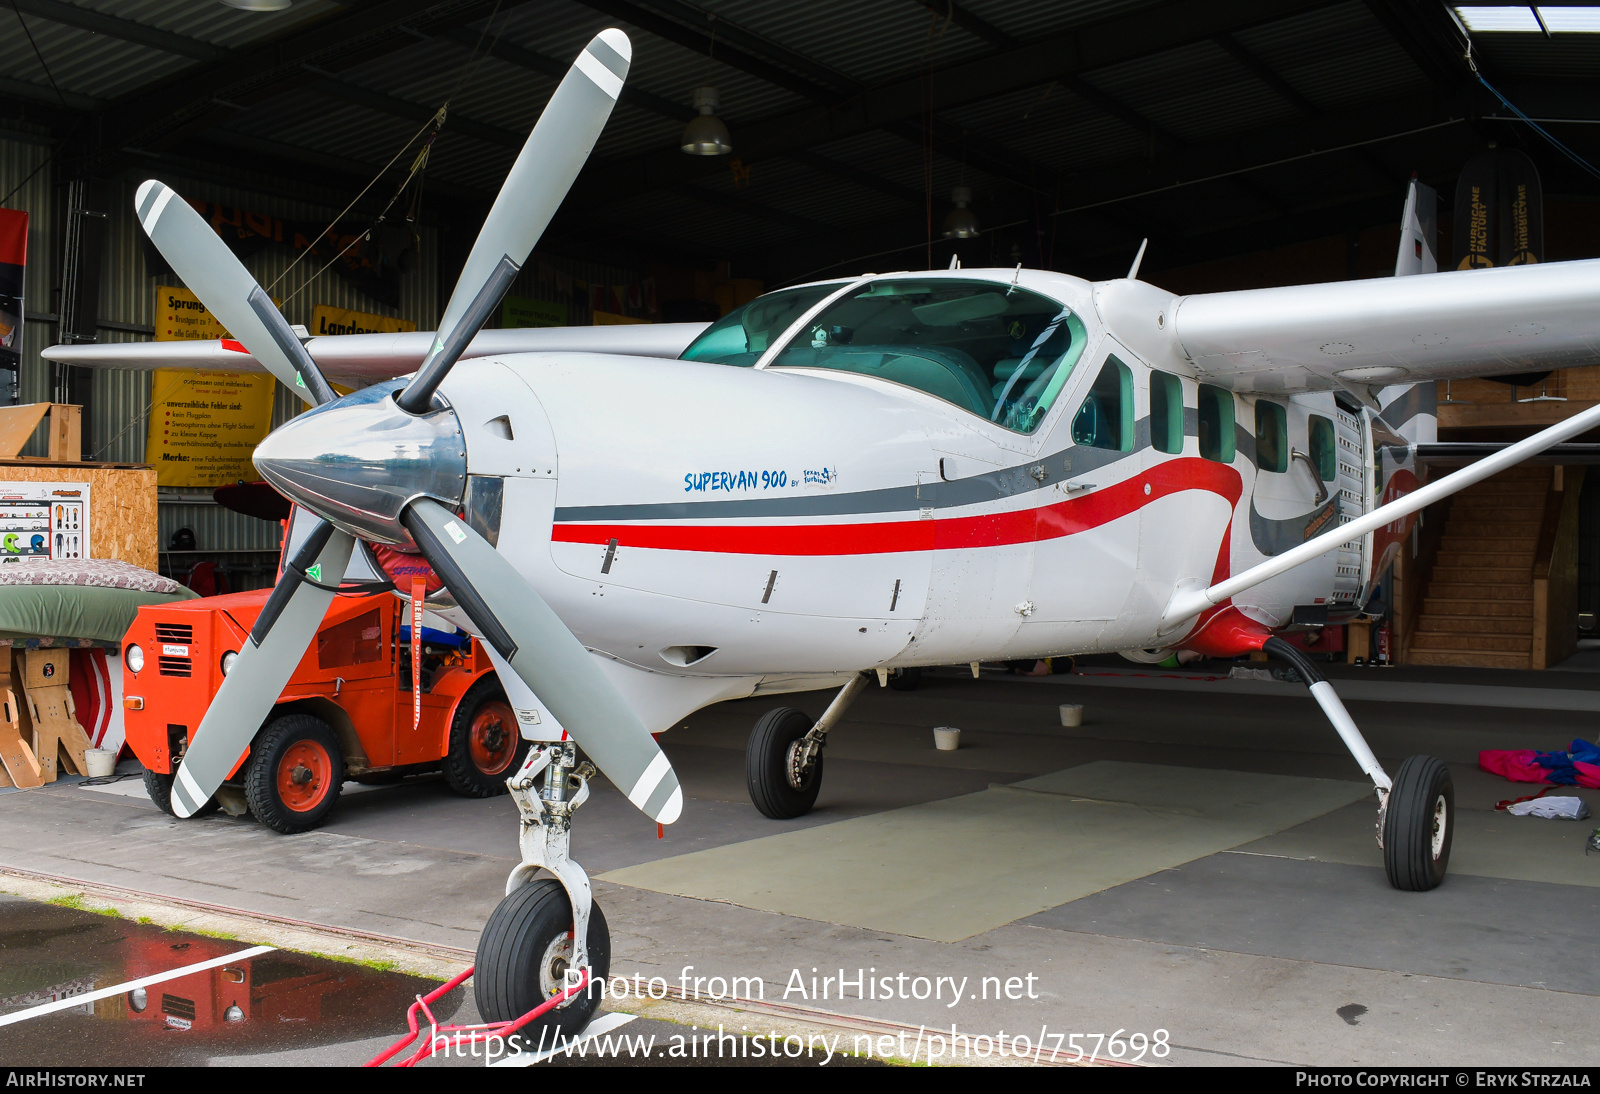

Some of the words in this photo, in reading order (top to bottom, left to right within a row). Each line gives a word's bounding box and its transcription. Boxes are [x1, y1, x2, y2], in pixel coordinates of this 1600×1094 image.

[1470, 186, 1480, 253] HURRICANE
[1477, 203, 1487, 253] FACTORY
[168, 296, 209, 313] Sprung
[175, 315, 199, 326] Brustgurt
[174, 329, 184, 338] alle
[185, 330, 200, 339] Griffe
[201, 331, 208, 339] da
[225, 380, 253, 388] mitdenken
[166, 401, 209, 409] unverzeihliche
[210, 402, 228, 410] Fehler
[228, 402, 243, 410] sind:
[171, 421, 206, 429] Swoopturns
[199, 431, 218, 439] Kappe
[170, 440, 223, 449] unverhältnismäßig
[162, 453, 190, 462] Merke:
[204, 455, 245, 464] Fallschirmkappe
[684, 470, 758, 492] SUPERVAN
[761, 470, 788, 490] 900
[791, 479, 800, 487] BY
[804, 475, 827, 485] Turbine
[392, 566, 431, 576] SUPERVAN
[414, 600, 422, 640] REMOVE
